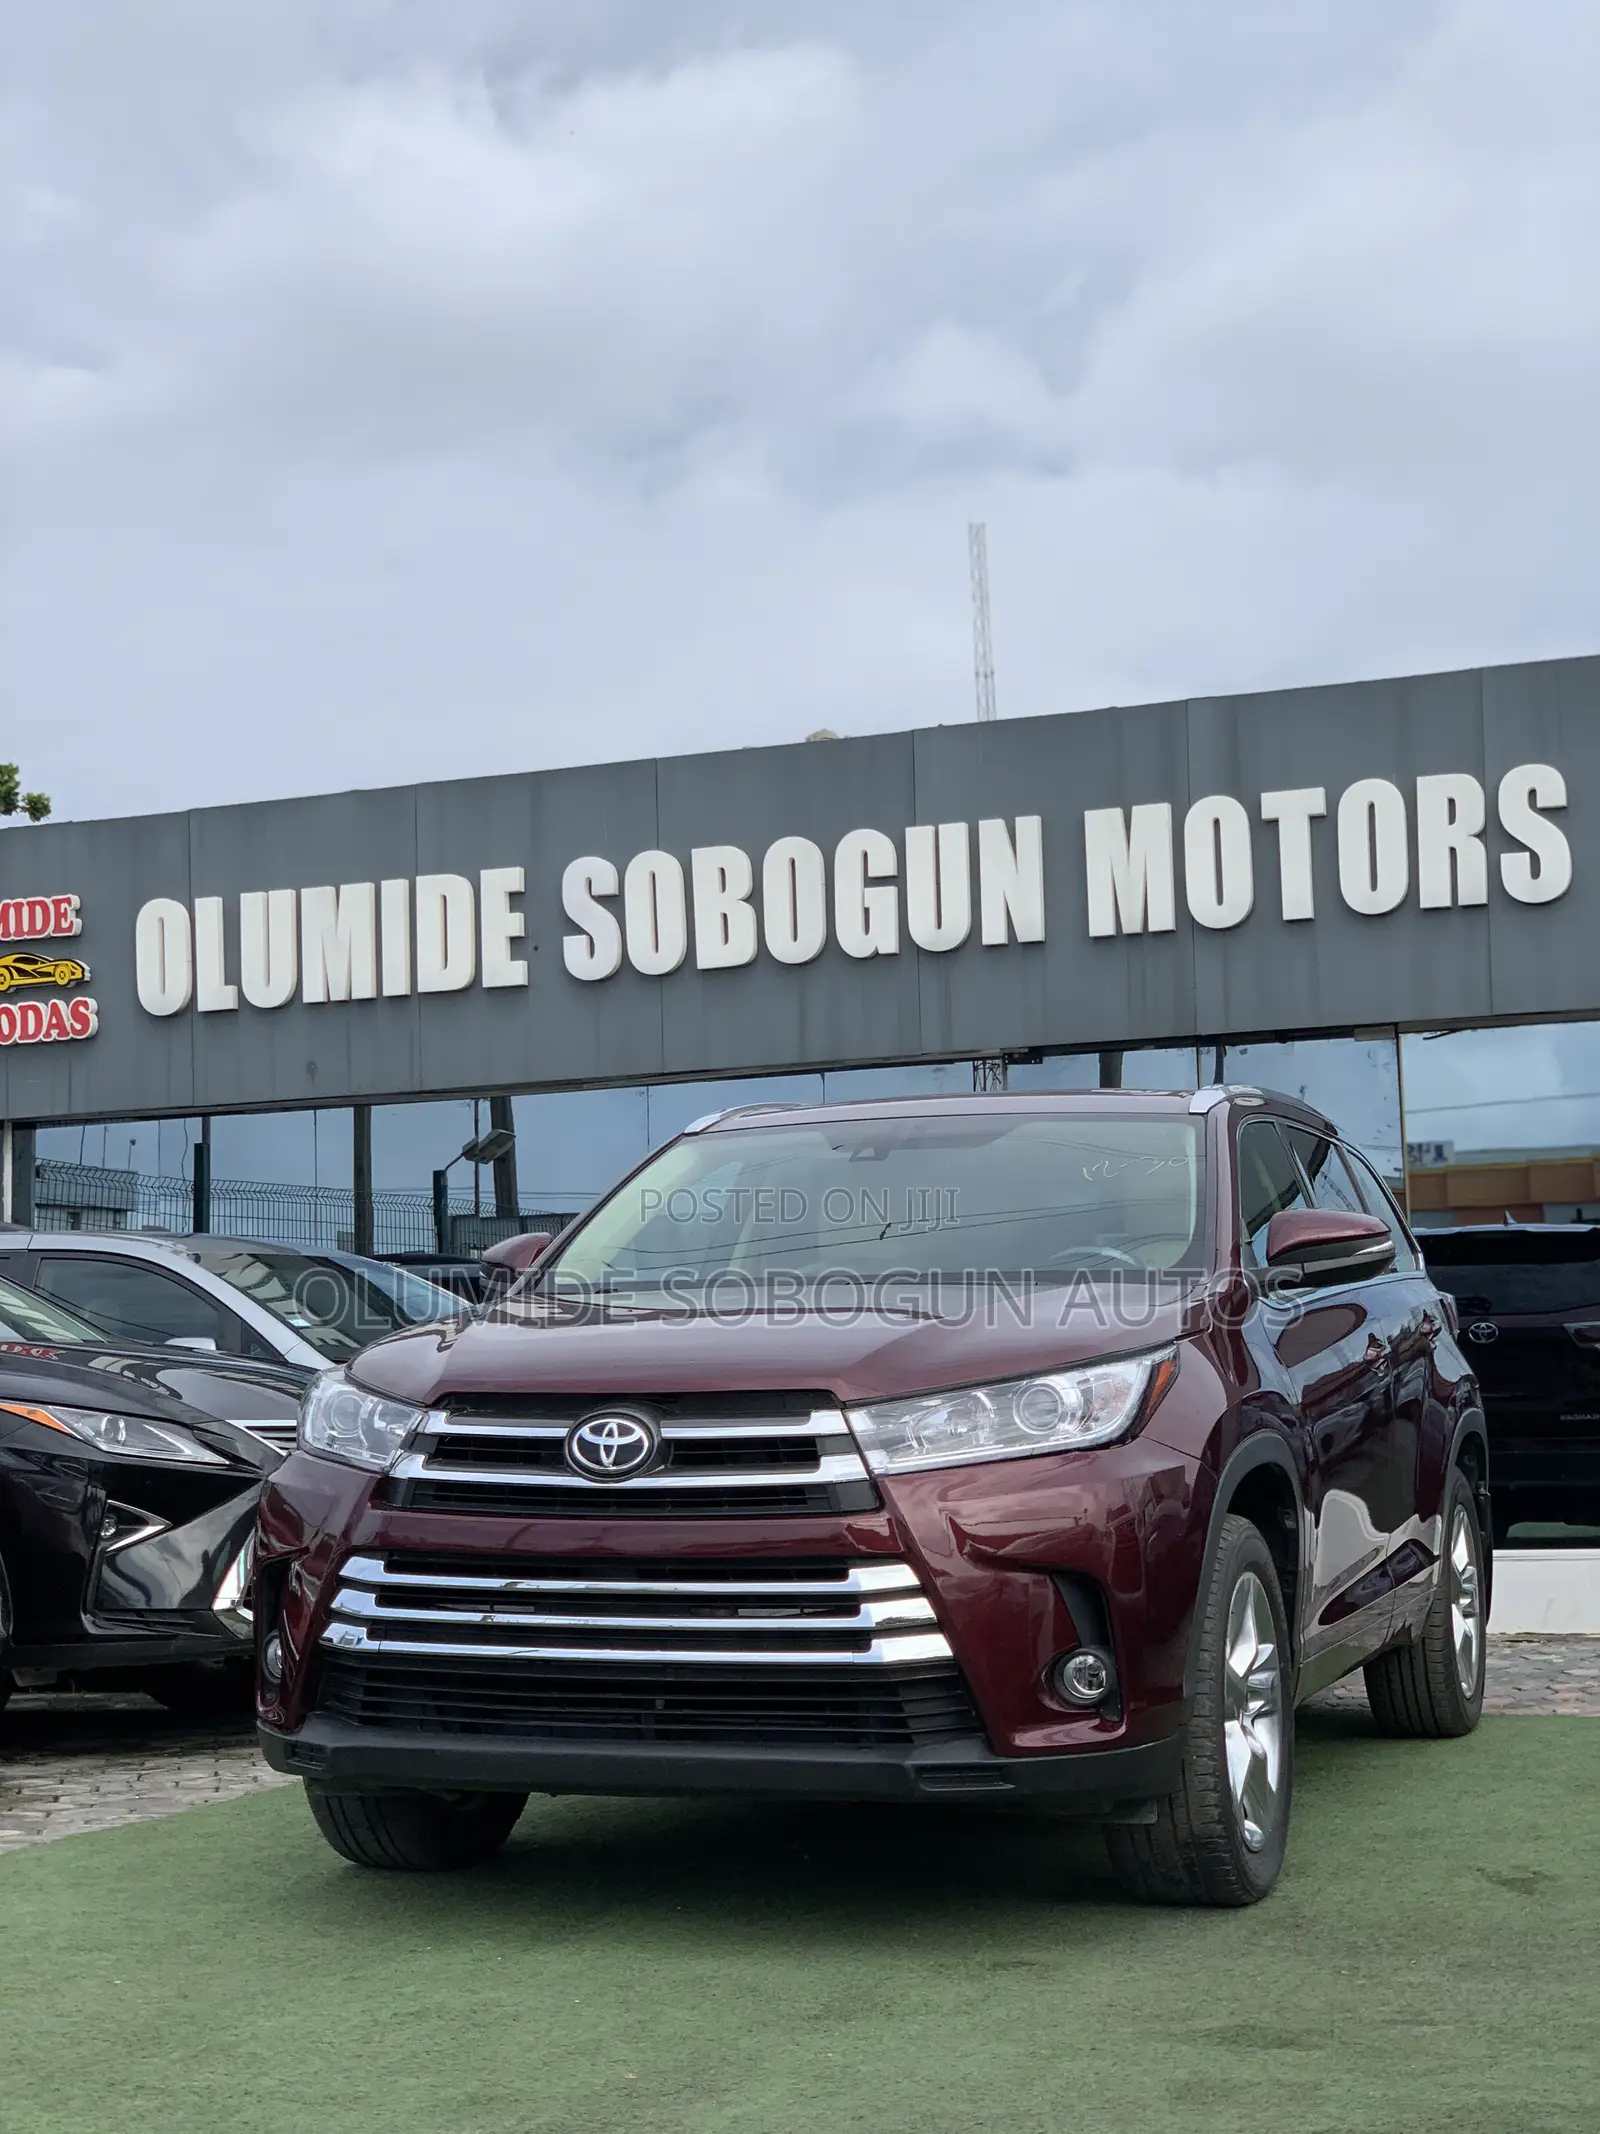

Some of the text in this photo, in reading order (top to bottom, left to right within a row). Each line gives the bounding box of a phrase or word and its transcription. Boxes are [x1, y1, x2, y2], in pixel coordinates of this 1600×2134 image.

[135, 763, 1573, 1017] OLUMIDE SOBOGUN MOTORS
